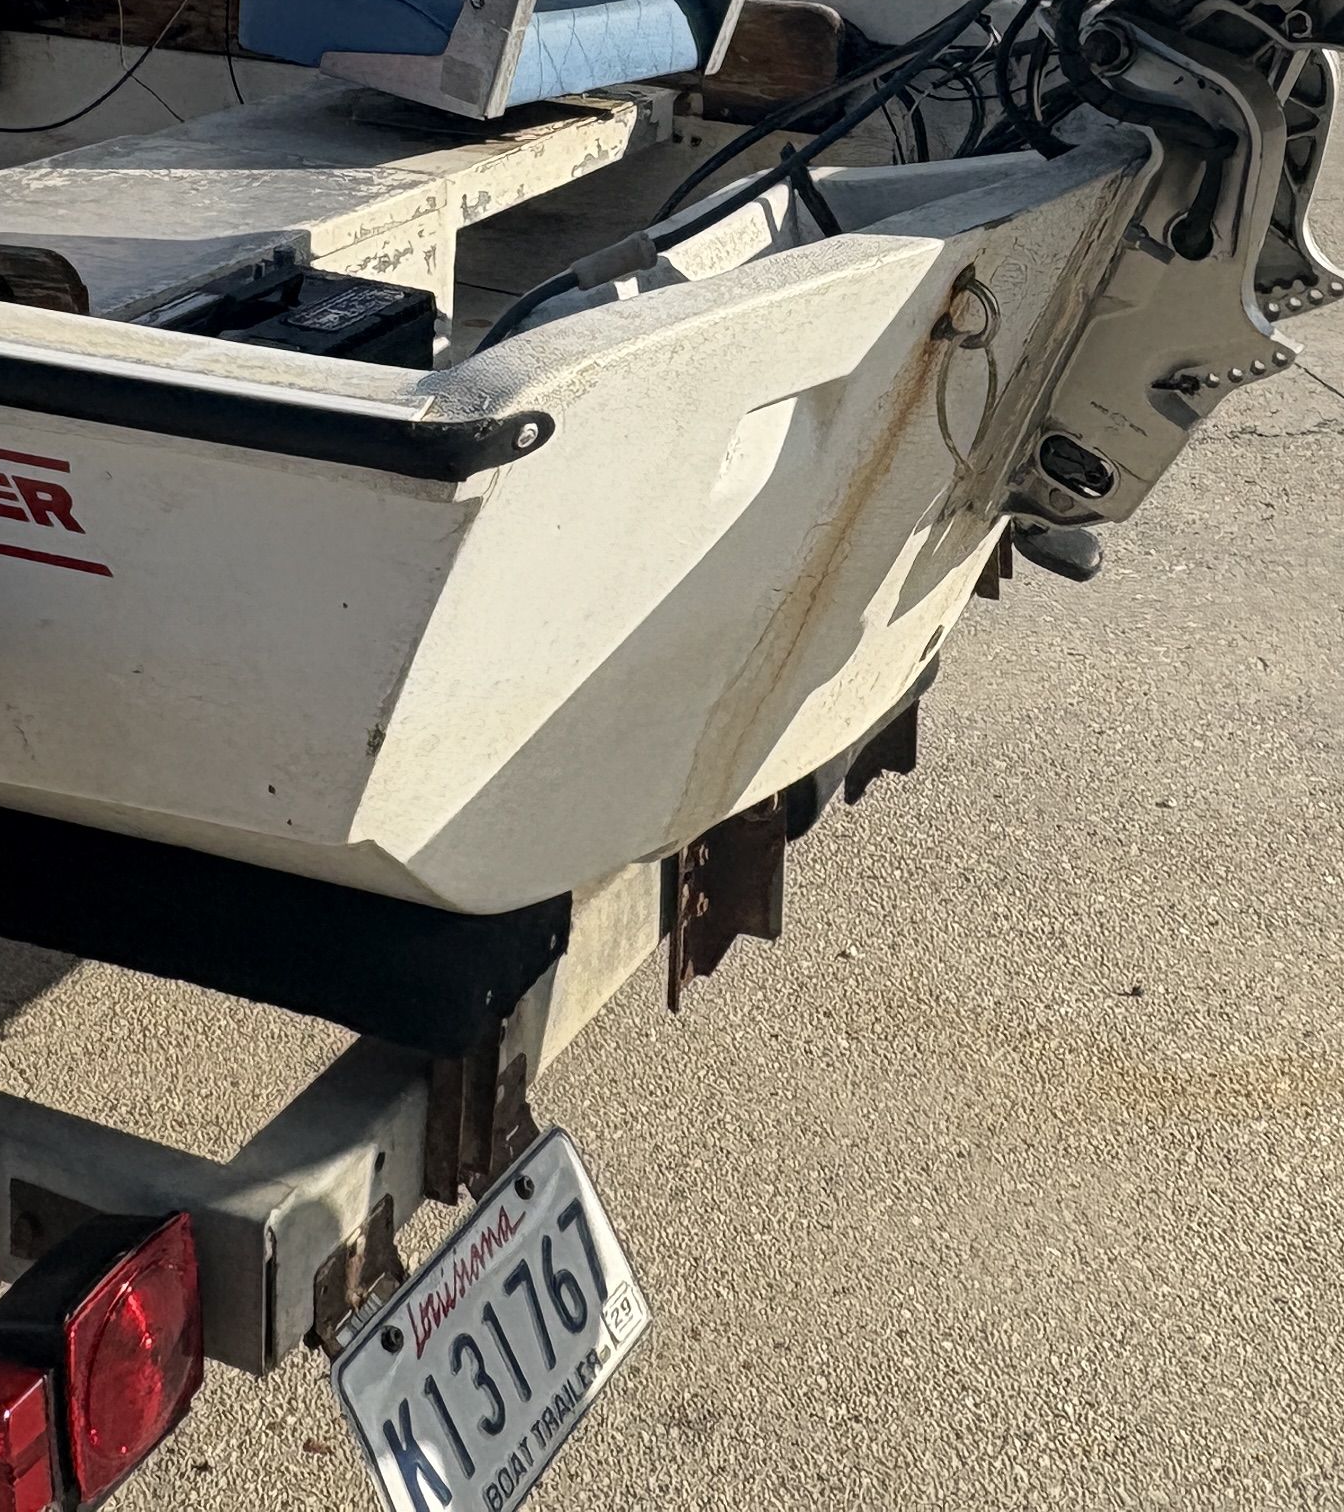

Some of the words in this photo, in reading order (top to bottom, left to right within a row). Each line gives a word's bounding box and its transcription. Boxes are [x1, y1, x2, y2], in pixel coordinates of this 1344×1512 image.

[382, 1197, 609, 1512] K131767
[406, 1205, 526, 1360] Louisiana
[482, 1436, 538, 1512] BOAT
[530, 1347, 604, 1451] TRAILER
